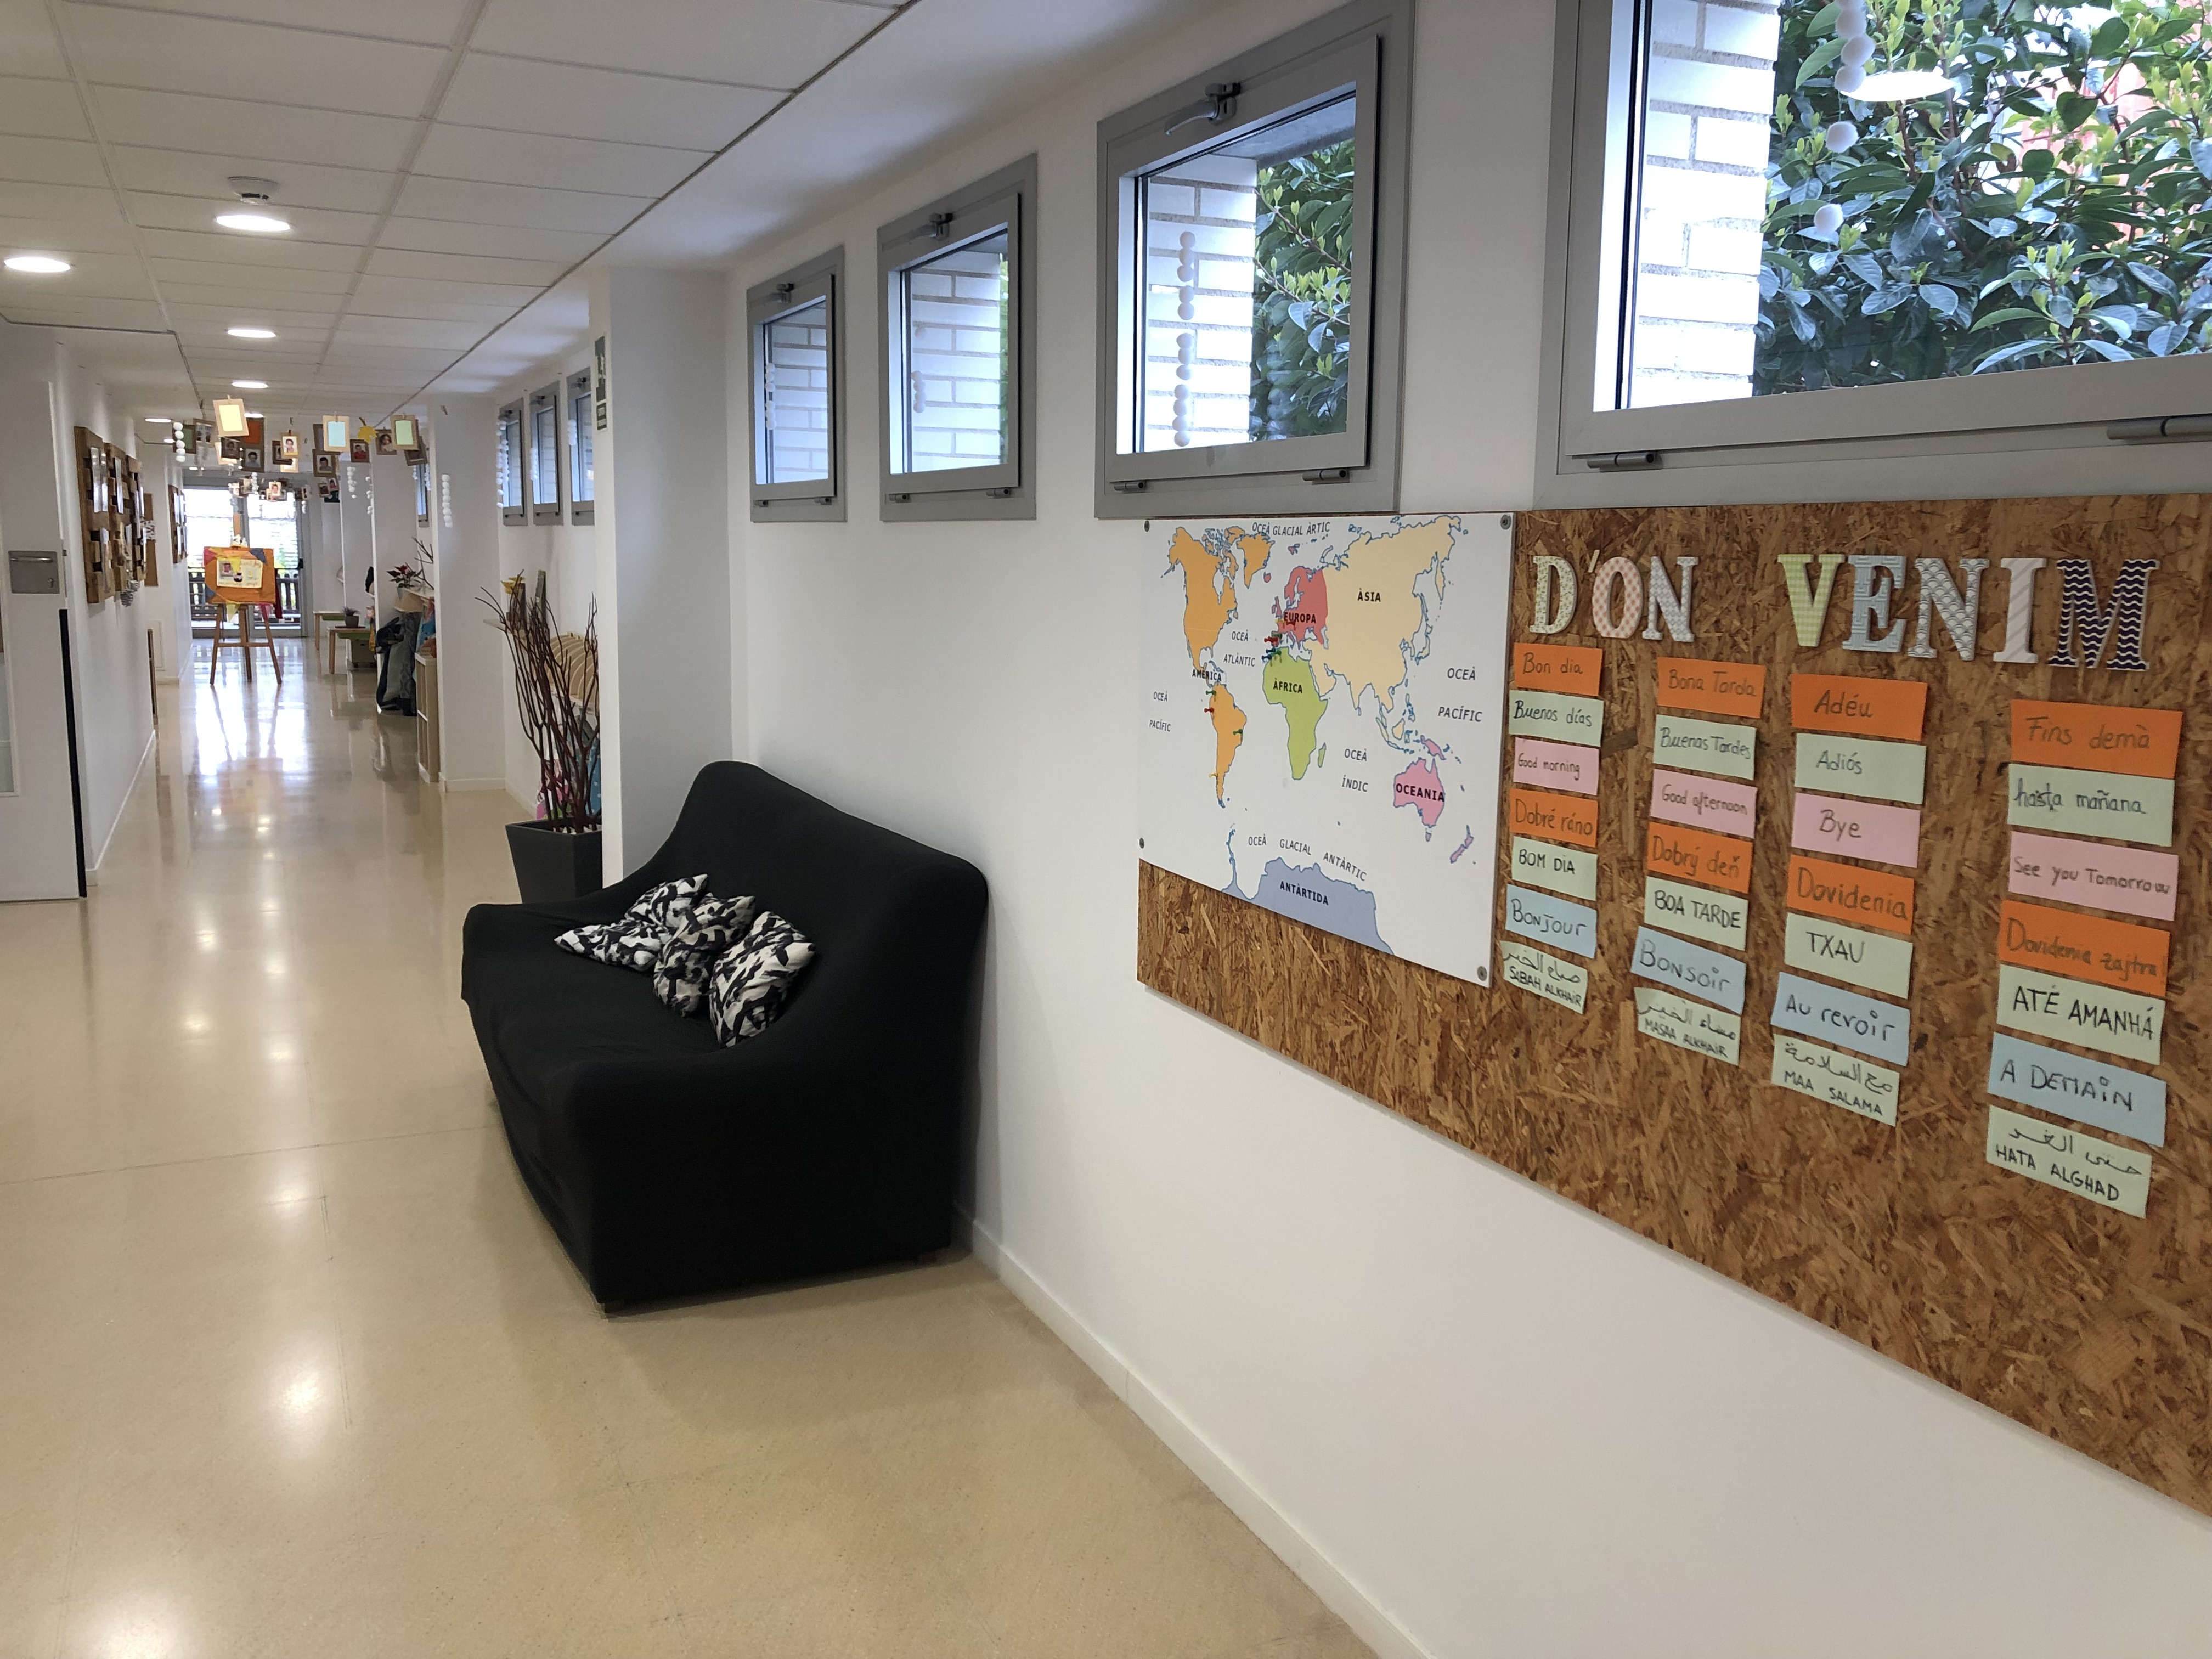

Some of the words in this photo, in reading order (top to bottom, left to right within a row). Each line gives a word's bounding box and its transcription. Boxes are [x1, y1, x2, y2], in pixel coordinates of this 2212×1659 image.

[1252, 522, 1270, 535] OCEÀ
[1272, 525, 1304, 536] GLACIAL
[1306, 521, 1330, 535] ÀRTIC
[1357, 588, 1381, 602] ÀSIA
[1283, 611, 1317, 624] EUROPA
[1530, 549, 1700, 642] D'ON
[1777, 553, 2160, 672] VENIM
[1231, 629, 1249, 642] OCEÀ
[1223, 652, 1256, 667] ATLÀNTIC
[1447, 666, 1476, 681] OCEÀ
[1522, 652, 1551, 675] Bon
[1560, 658, 1583, 675] dia
[1153, 691, 1168, 702] OCEÀ
[1272, 678, 1303, 694] ÀFRICA
[1667, 668, 1705, 691] Bona
[1713, 670, 1757, 697] Tarda
[1437, 705, 1483, 723] PACÍFIC
[1513, 699, 1558, 722] Buenos
[1565, 707, 1593, 727] días
[1813, 689, 1874, 718] Adéu
[1149, 719, 1171, 732] PACÍFIC
[2025, 716, 2073, 746] Fins
[2089, 724, 2151, 750] demà
[1344, 748, 1368, 761] OCEÀ
[1660, 726, 1708, 751] Buenas
[1709, 735, 1752, 760] Tardes
[1517, 752, 1538, 769] Good
[1543, 760, 1581, 781] morning
[1815, 749, 1863, 775] Adiós
[1341, 774, 1369, 792] ÍNDIC
[1395, 783, 1445, 803] OCEANIA
[2013, 777, 2064, 811] hasta
[2075, 789, 2147, 815] mañana
[1661, 783, 1688, 805] Good
[1692, 791, 1748, 815] afternoon
[1515, 798, 1556, 829] Dobré
[1561, 812, 1593, 836] ráno
[1819, 809, 1863, 842] Bye
[1248, 833, 1267, 846] OCEÀ
[1279, 838, 1312, 856] GLACIAL
[1322, 851, 1368, 882] ANTÀRTIC
[1518, 848, 1546, 869] BOM
[1652, 834, 1701, 877] Dobrý
[1707, 850, 1741, 878] deň
[2013, 856, 2041, 877] See
[2052, 866, 2079, 887] you
[2084, 868, 2171, 895] Tomorrow
[1279, 880, 1329, 906] ANTÀRTIDA
[1654, 889, 1685, 916] BOA
[1690, 900, 1742, 929] TARDE
[1805, 931, 1865, 963] TXAU
[1785, 994, 1811, 1017] Au
[1821, 1009, 1896, 1042] revoir
[2012, 985, 2061, 1015] ATÉ
[2068, 998, 2154, 1041] AMANHÁ
[2000, 1059, 2016, 1083] A
[1784, 1070, 1814, 1092] MAA
[1828, 1087, 1883, 1116] SALAMA
[1995, 1143, 2037, 1171] HATA
[2050, 1163, 2121, 1202] ALGHAD
